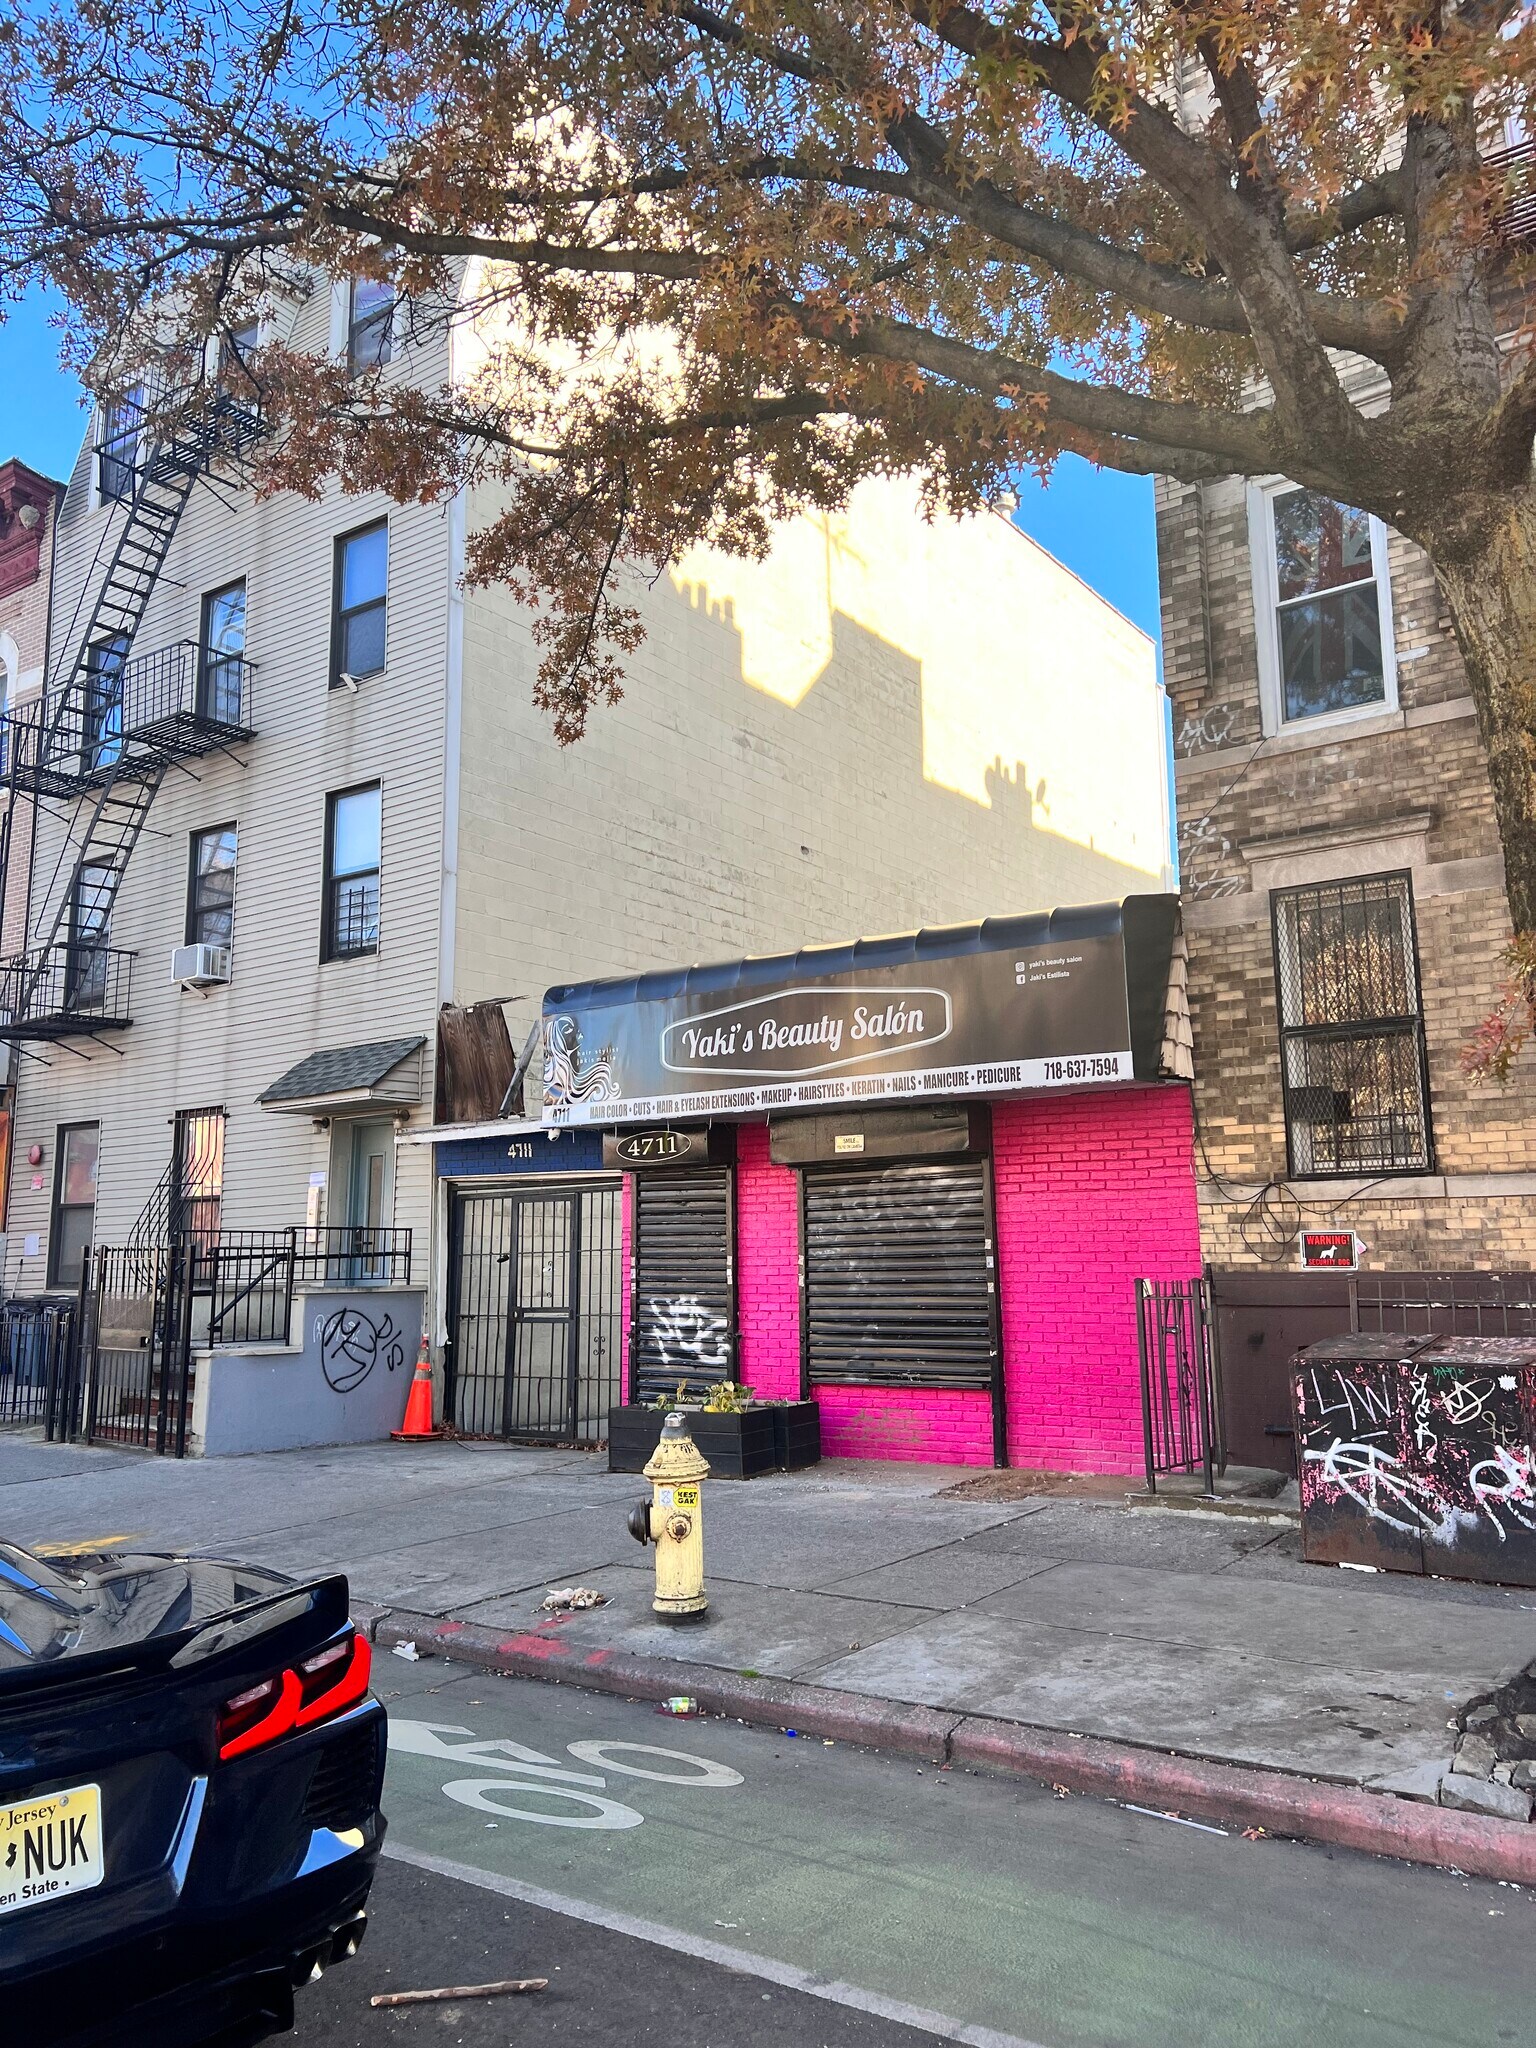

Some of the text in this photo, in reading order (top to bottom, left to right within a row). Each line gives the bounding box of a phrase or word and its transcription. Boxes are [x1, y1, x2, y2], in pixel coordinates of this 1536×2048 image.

[1046, 957, 1065, 965] beauty
[682, 1001, 924, 1058] Yaki's Beauty Salón
[594, 1047, 619, 1055] stylist
[1044, 1057, 1119, 1080] 718-637-7594
[589, 1066, 1021, 1119] HAIR COLOR CUTS HAIR & EYELASH EXTENSIONS MAKEUP HAIRSTYLES KERATIN NAILS MANICURE PEDICURE
[552, 1107, 570, 1123] 4711
[507, 1142, 533, 1159] 4711
[627, 1136, 678, 1157] 4711
[1306, 1235, 1350, 1245] WARNING!
[6, 1805, 57, 1830] Jersey
[24, 1813, 89, 1880] NUK
[22, 1880, 59, 1899] State
